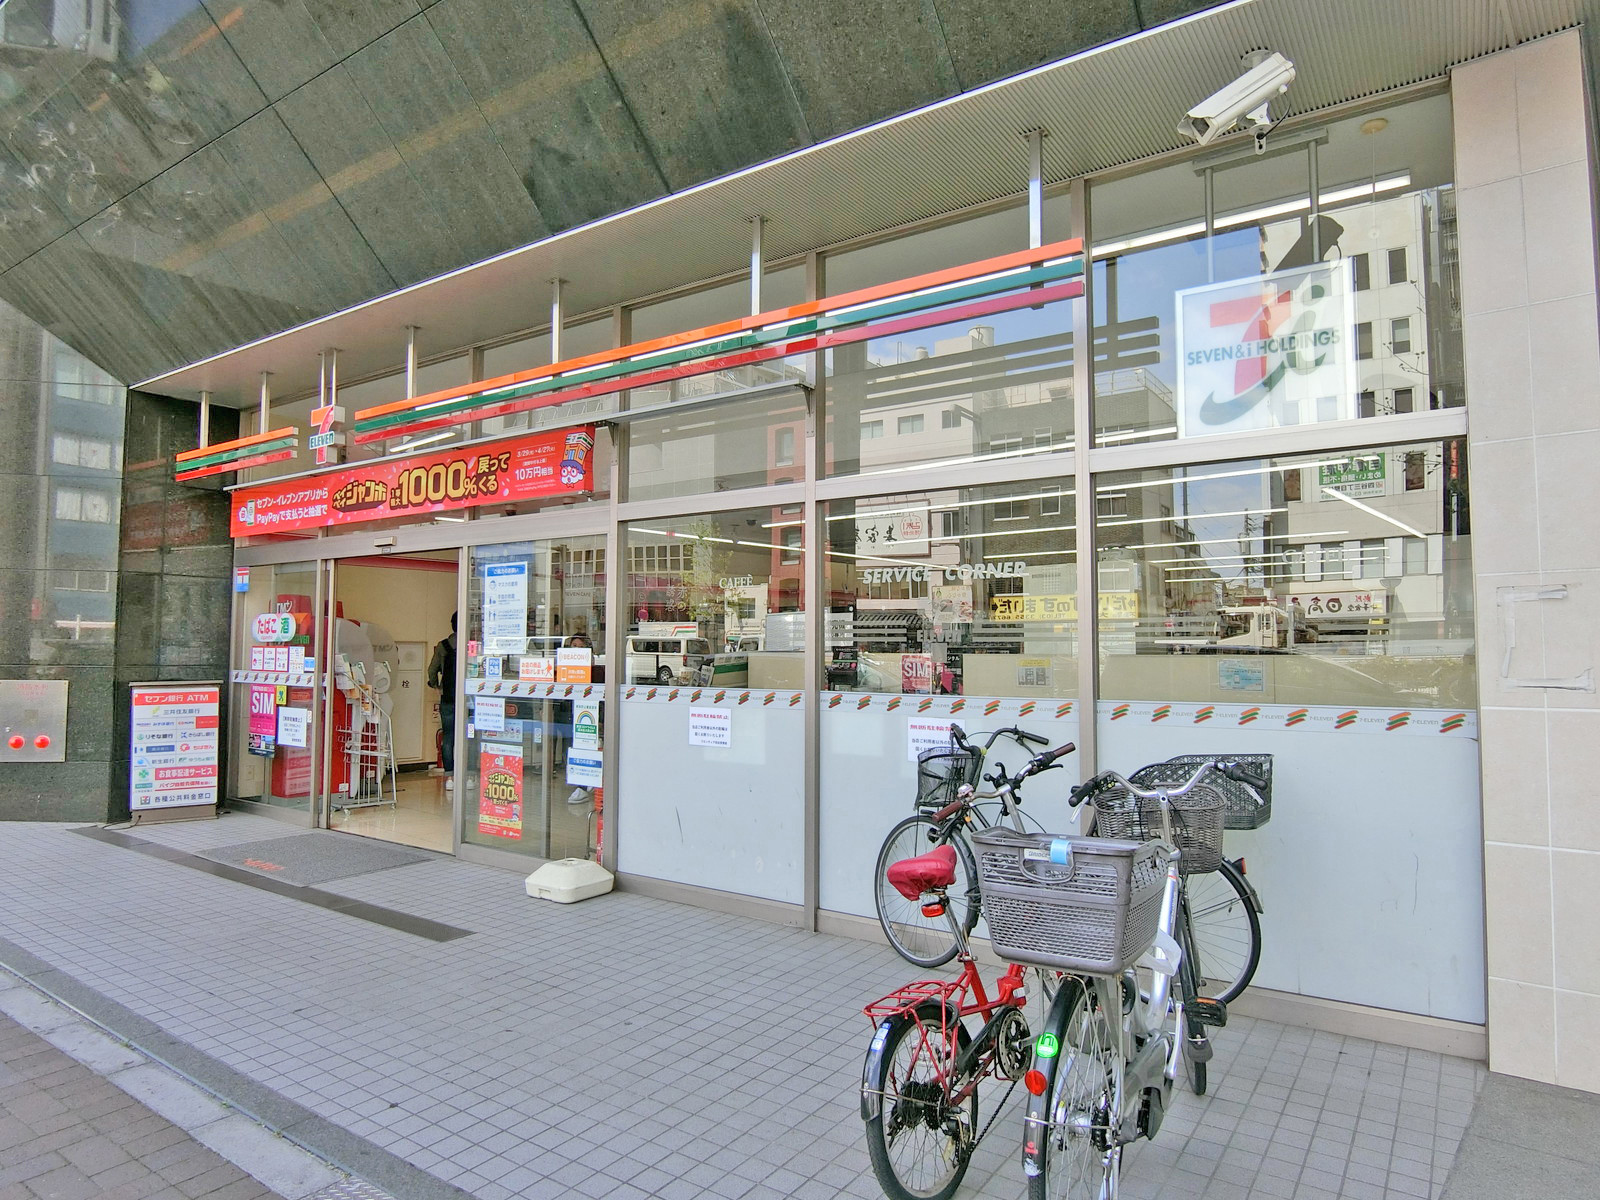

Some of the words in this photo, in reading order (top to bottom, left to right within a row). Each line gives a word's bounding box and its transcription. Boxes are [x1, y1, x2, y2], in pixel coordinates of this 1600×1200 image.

[1256, 331, 1341, 356] HOLDINGS
[863, 565, 933, 584] SERVICE
[945, 561, 1027, 581] CORNER
[257, 618, 277, 634] たばこ
[281, 617, 290, 634] 酒
[145, 695, 184, 703] セブン銀行
[187, 694, 209, 702] ATM
[251, 692, 274, 715] SIM
